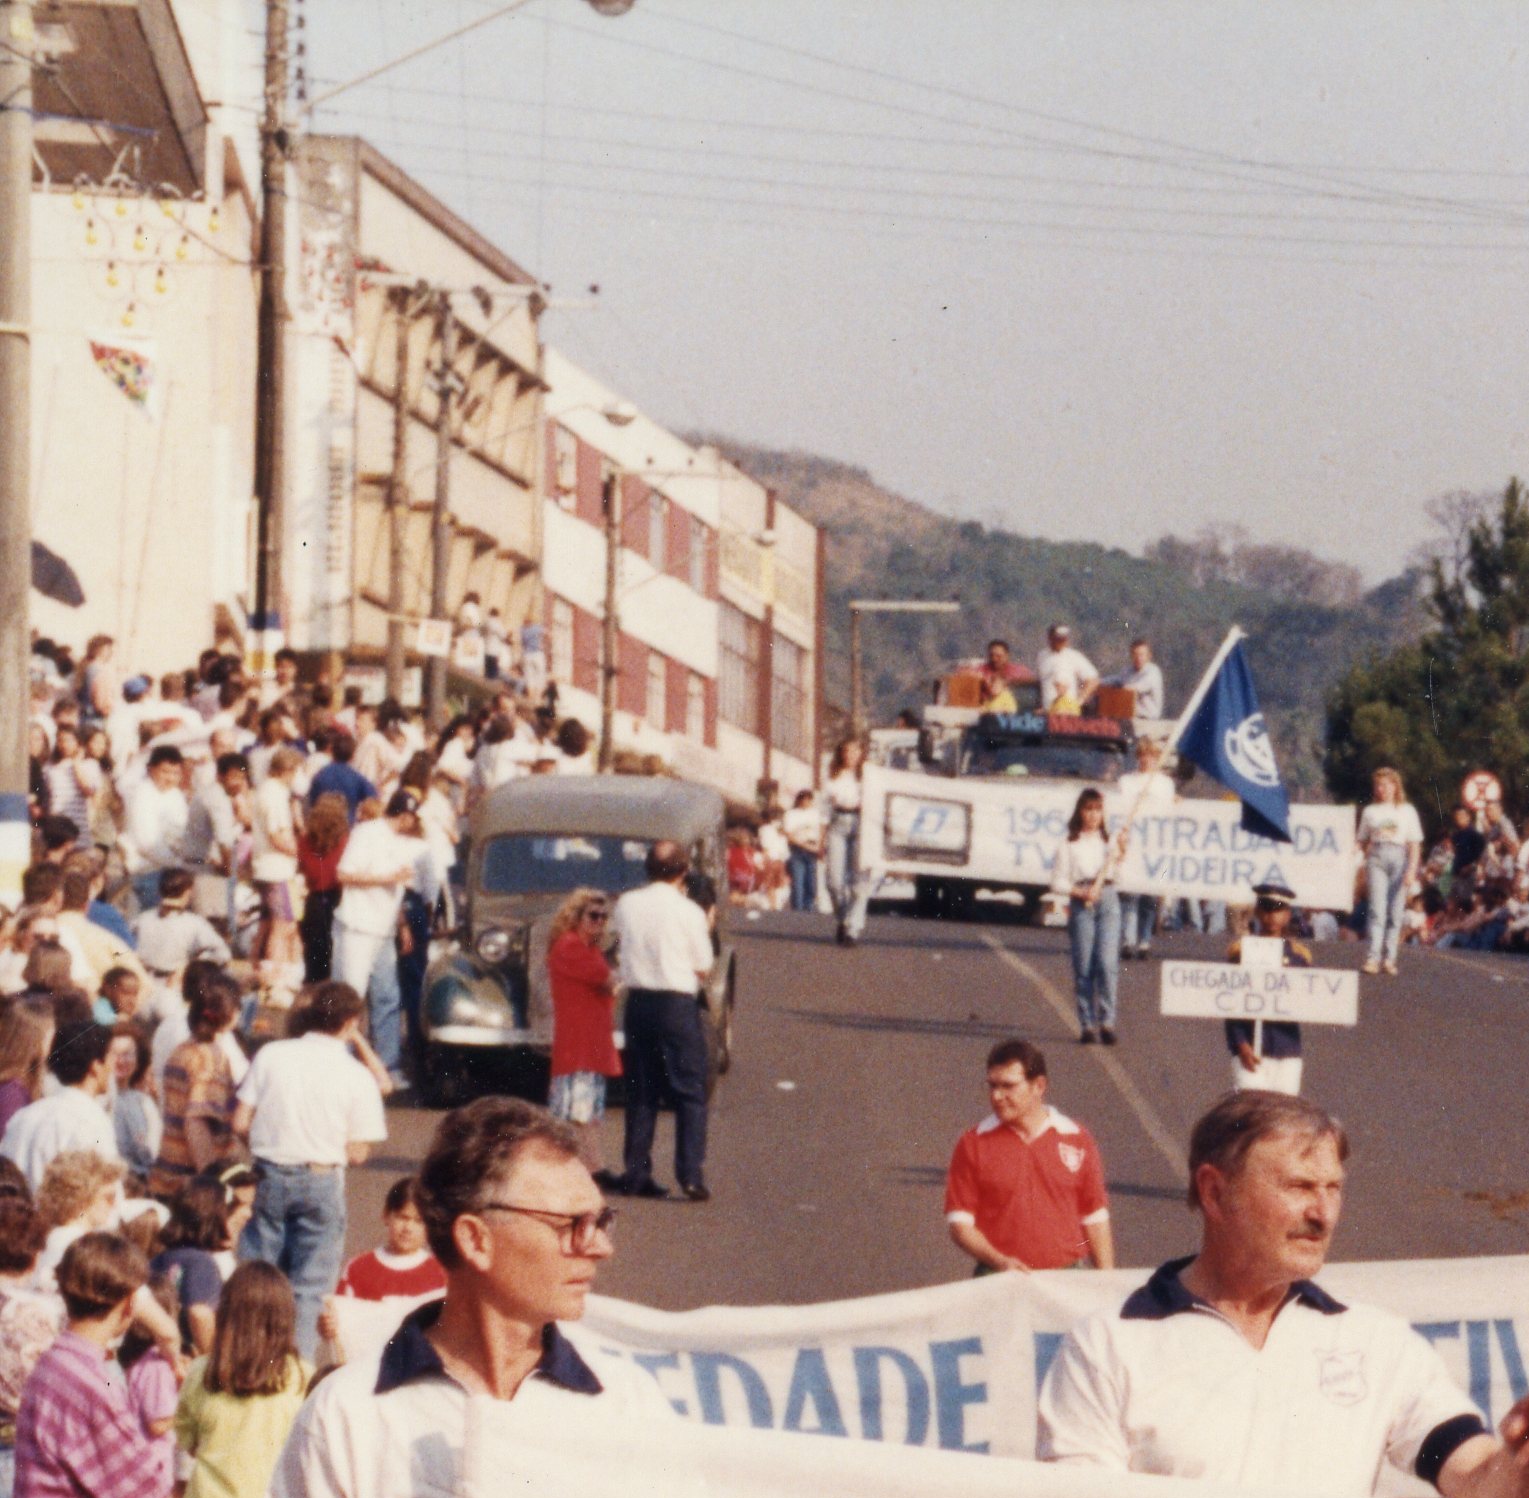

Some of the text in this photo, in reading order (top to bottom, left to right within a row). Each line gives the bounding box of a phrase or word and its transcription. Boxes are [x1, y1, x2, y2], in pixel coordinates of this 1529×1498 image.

[1294, 824, 1339, 856] DA
[1143, 852, 1289, 889] VIDEIRA
[1170, 967, 1343, 995] CHEGADA DA TV
[1215, 991, 1292, 1015] CDL
